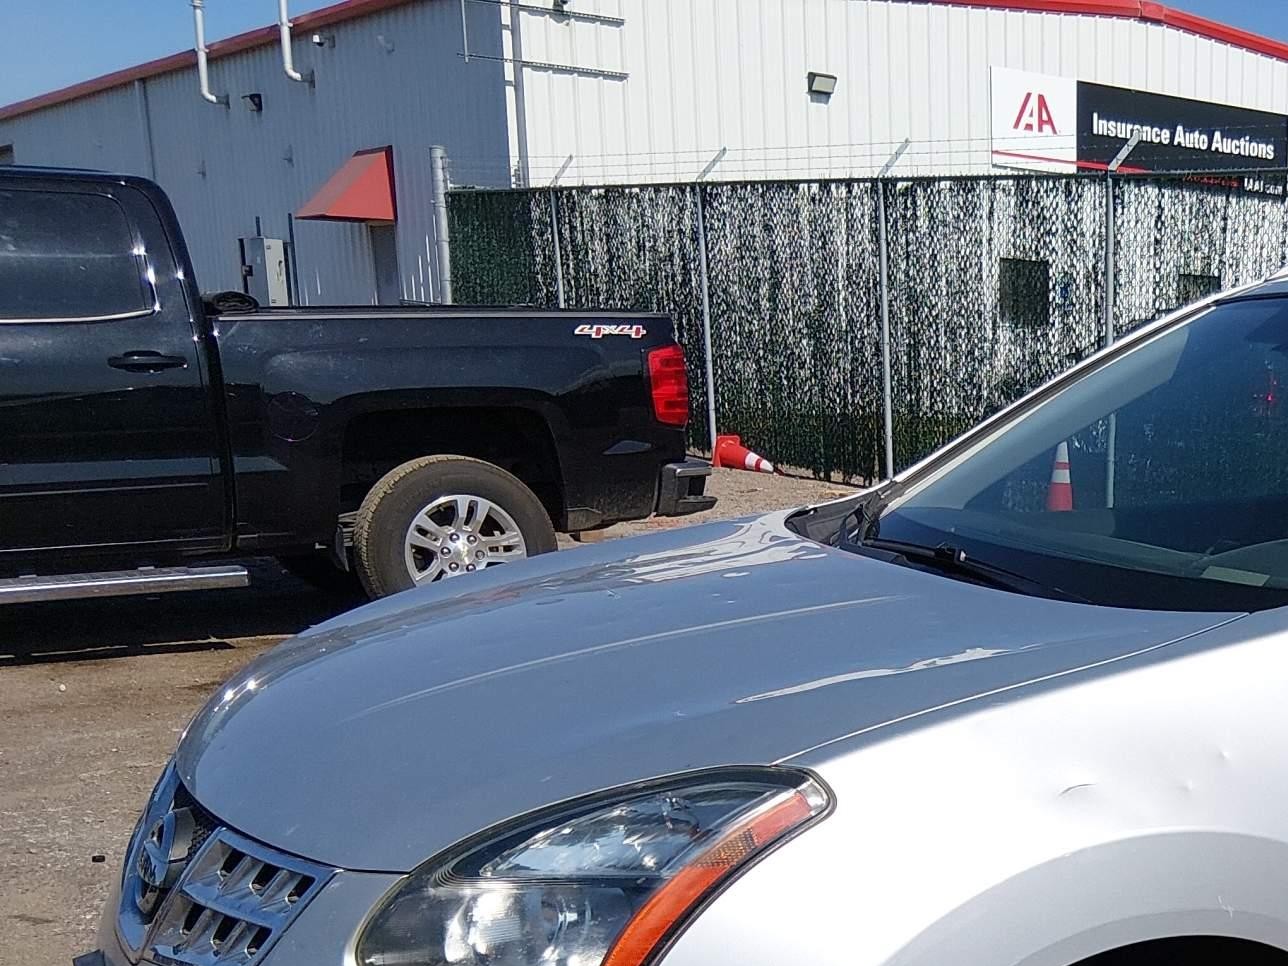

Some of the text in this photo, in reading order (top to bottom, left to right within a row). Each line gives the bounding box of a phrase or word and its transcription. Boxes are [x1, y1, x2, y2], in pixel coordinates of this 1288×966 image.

[1092, 112, 1275, 160] Insurance Auto Auctions
